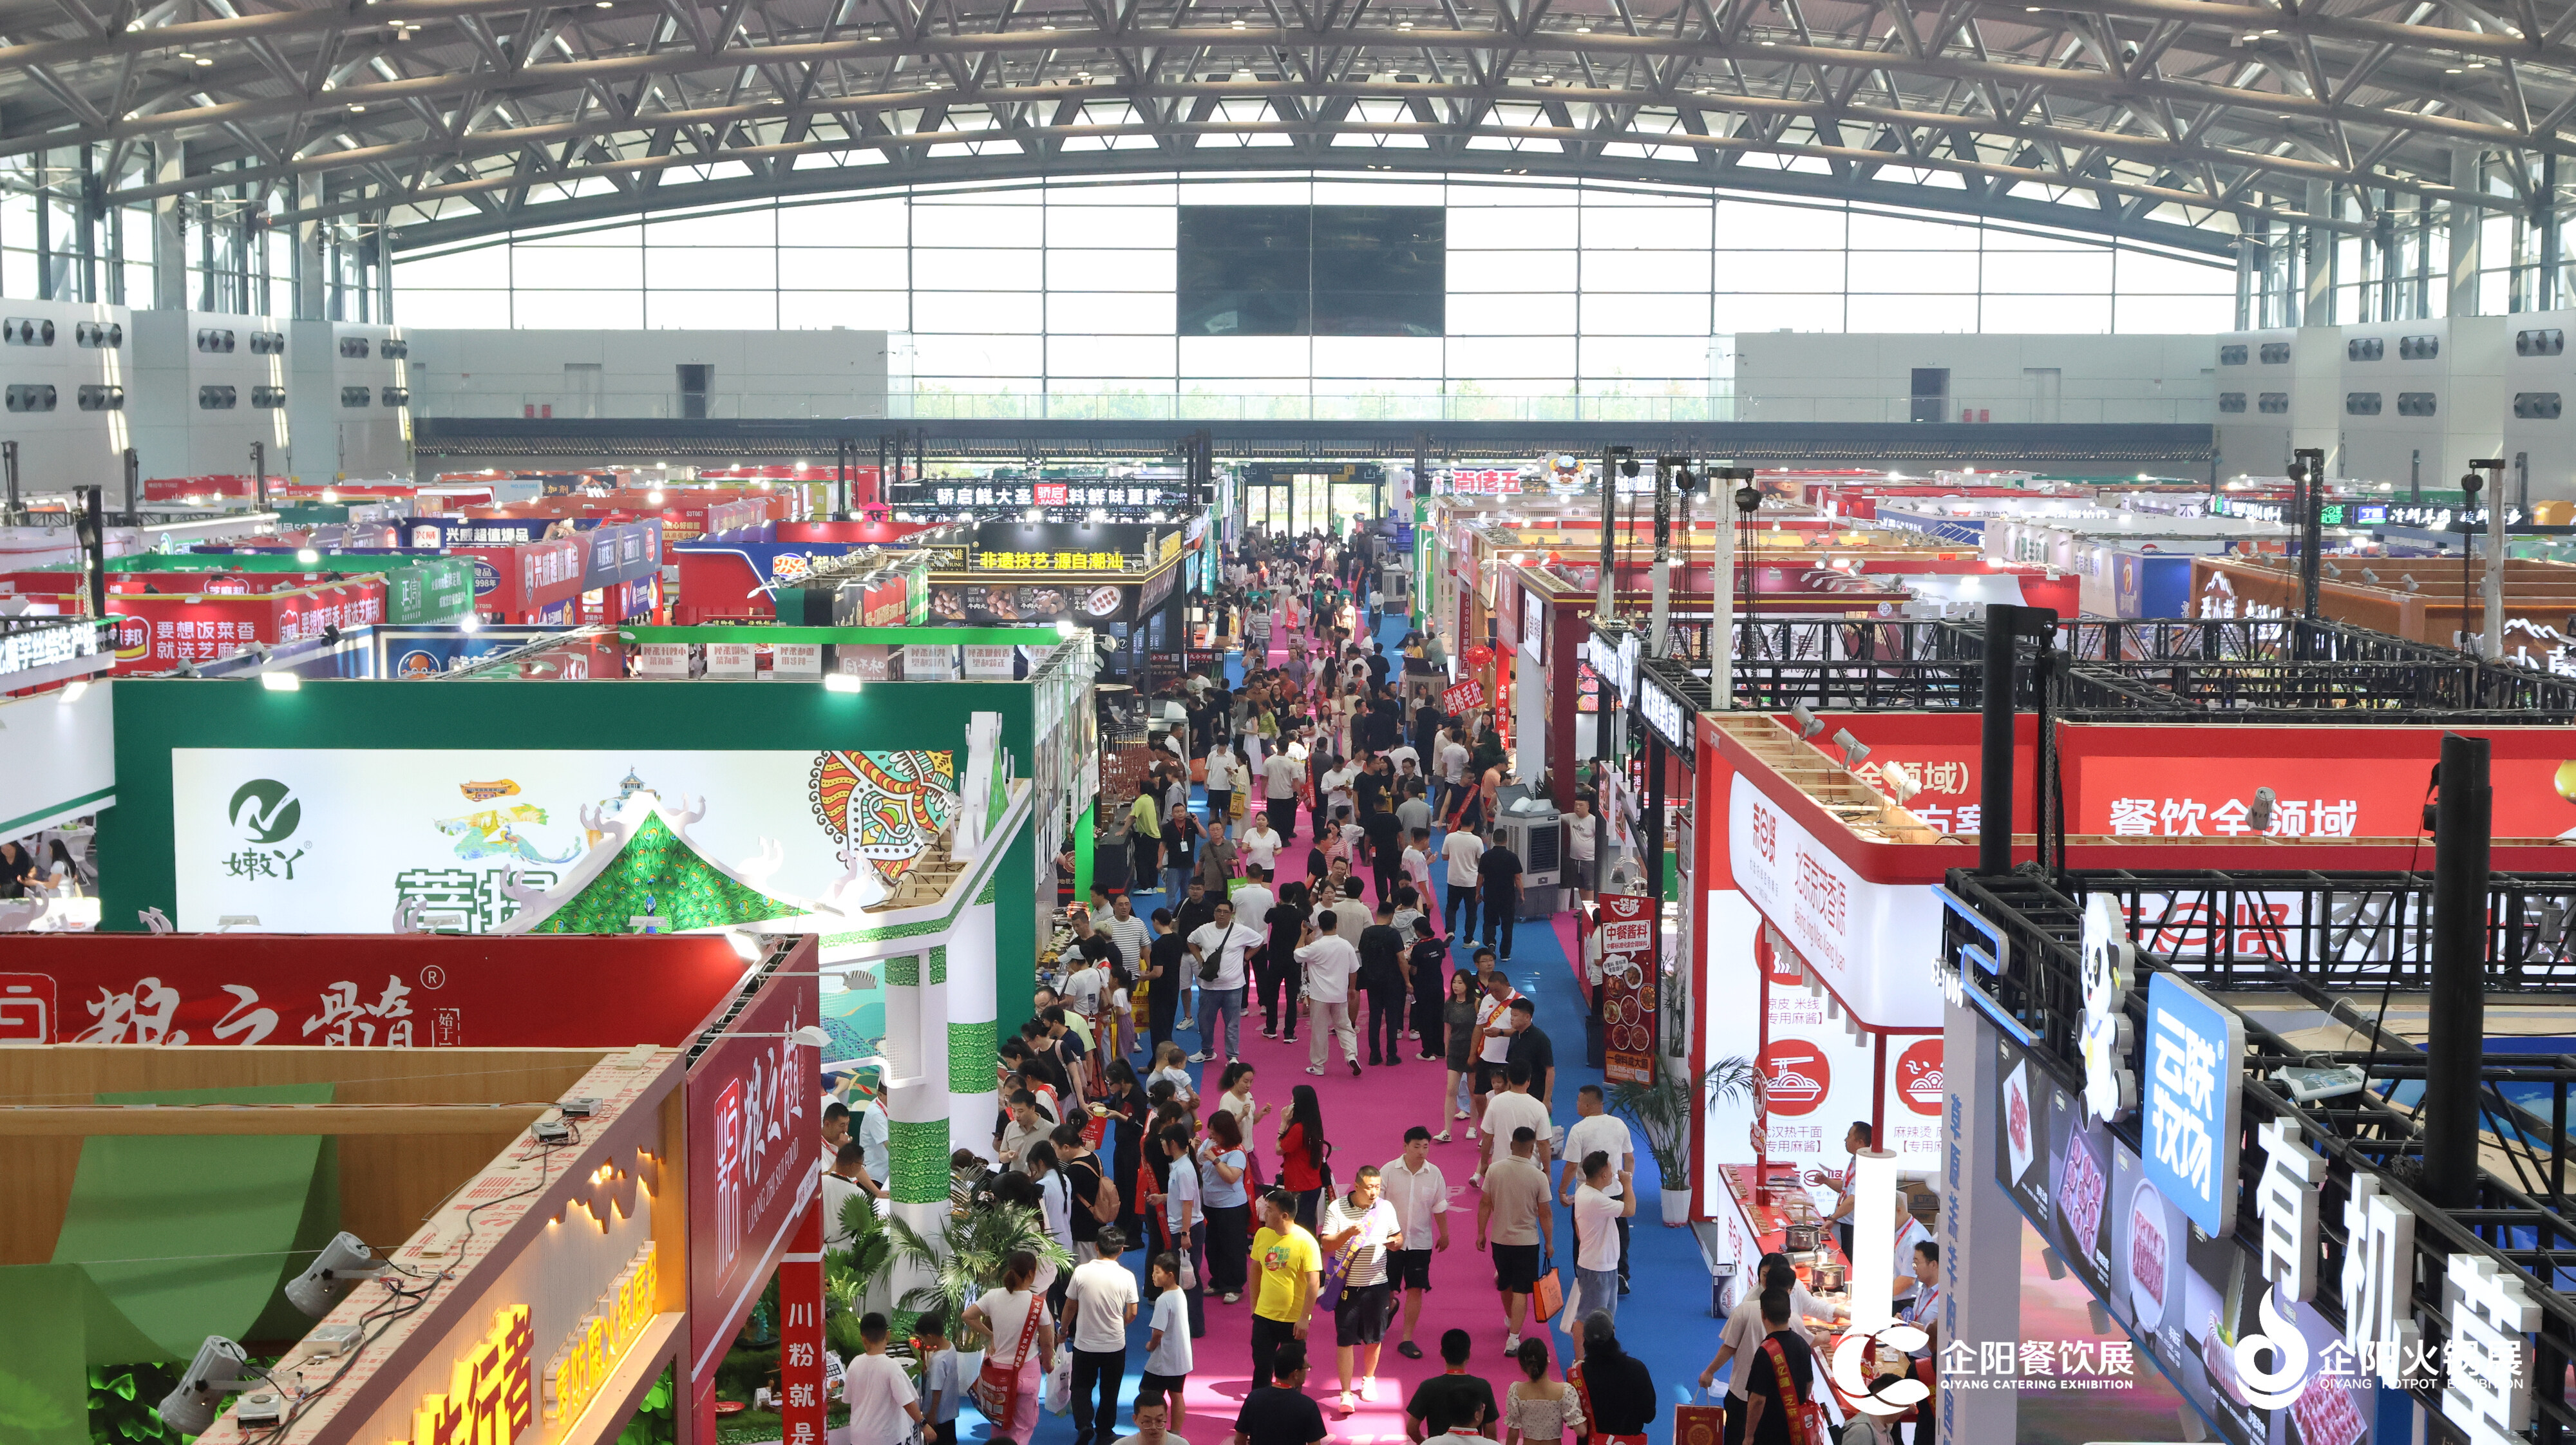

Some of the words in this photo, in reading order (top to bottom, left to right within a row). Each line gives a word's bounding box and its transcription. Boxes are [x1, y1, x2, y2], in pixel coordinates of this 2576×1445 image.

[937, 487, 1031, 505] 骄启鲜大圣
[1037, 486, 1063, 498] 骄启
[446, 527, 529, 543] 兴威超值爆品
[980, 551, 1049, 570] 非遗技艺
[1054, 552, 1124, 570] 源自潮汕
[156, 621, 256, 639] 要想饭菜香
[156, 642, 256, 659] 就选芝麻
[1443, 681, 1484, 715] 鸿格毛肚
[2109, 797, 2358, 837] 餐饮全领域
[222, 847, 305, 882] 嫩丫
[1794, 842, 1846, 938] 北京京茂香源
[1606, 923, 1648, 941] 中餐酱料
[1929, 957, 1964, 1009] S3-T006
[1794, 998, 1820, 1010] 米线
[2154, 1006, 2217, 1122] 云联
[1893, 1126, 1932, 1138] 麻辣烫
[2152, 1083, 2211, 1202] 牧场
[747, 1187, 766, 1235] LIANG
[765, 1171, 776, 1207] ZHI
[775, 1157, 784, 1191] SUI
[784, 1137, 799, 1176] FOOD
[788, 1302, 815, 1445] 川粉就是
